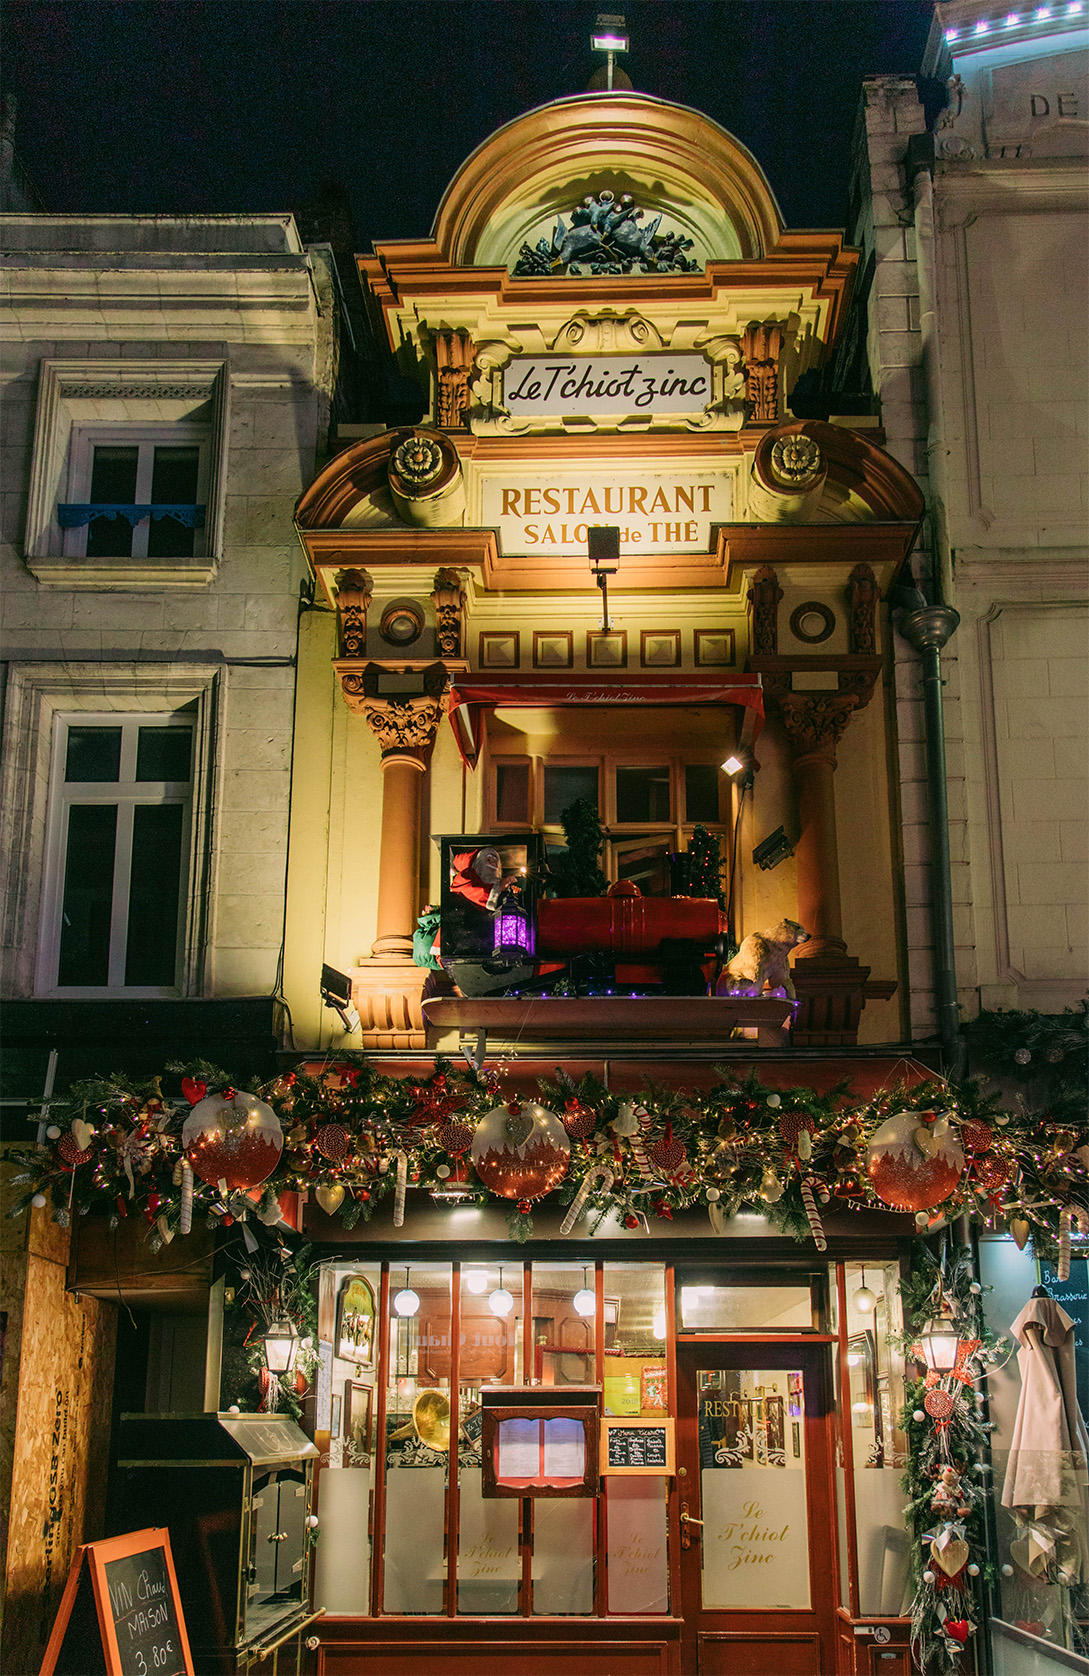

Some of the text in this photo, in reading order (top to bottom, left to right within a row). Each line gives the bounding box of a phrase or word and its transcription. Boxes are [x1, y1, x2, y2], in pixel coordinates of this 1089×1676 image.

[1030, 92, 1079, 117] DE
[508, 364, 707, 407] Le T'chiot zinc
[500, 485, 715, 518] RESTAURANT
[524, 520, 699, 544] SALO de THÉ
[742, 1501, 767, 1519] Le
[717, 1523, 790, 1541] T'chiot
[473, 1561, 501, 1577] Zinc
[727, 1545, 777, 1570] Zinc
